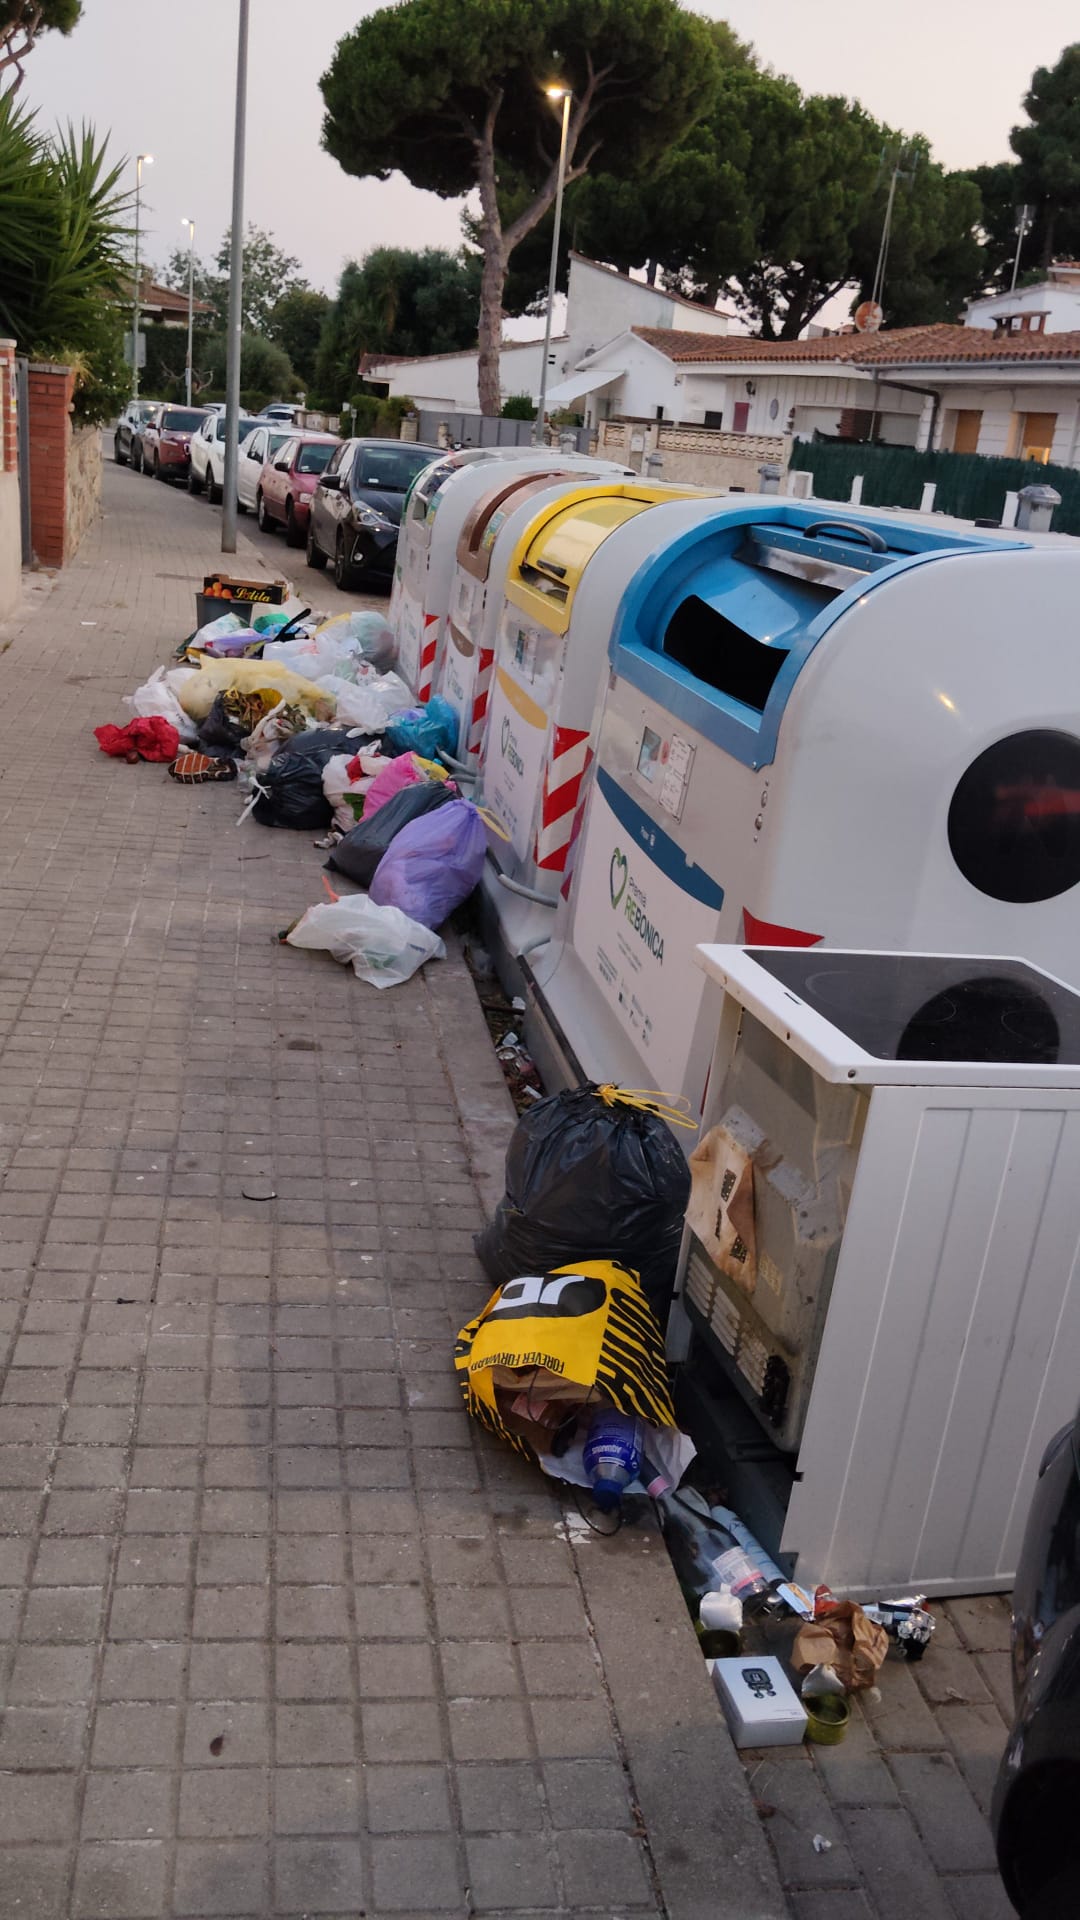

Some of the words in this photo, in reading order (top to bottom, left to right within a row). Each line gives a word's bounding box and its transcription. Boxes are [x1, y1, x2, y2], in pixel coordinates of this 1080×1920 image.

[235, 587, 271, 603] Lolita
[624, 893, 665, 968] REBONICA
[492, 1275, 586, 1312] JD
[522, 1351, 565, 1374] FOREVER
